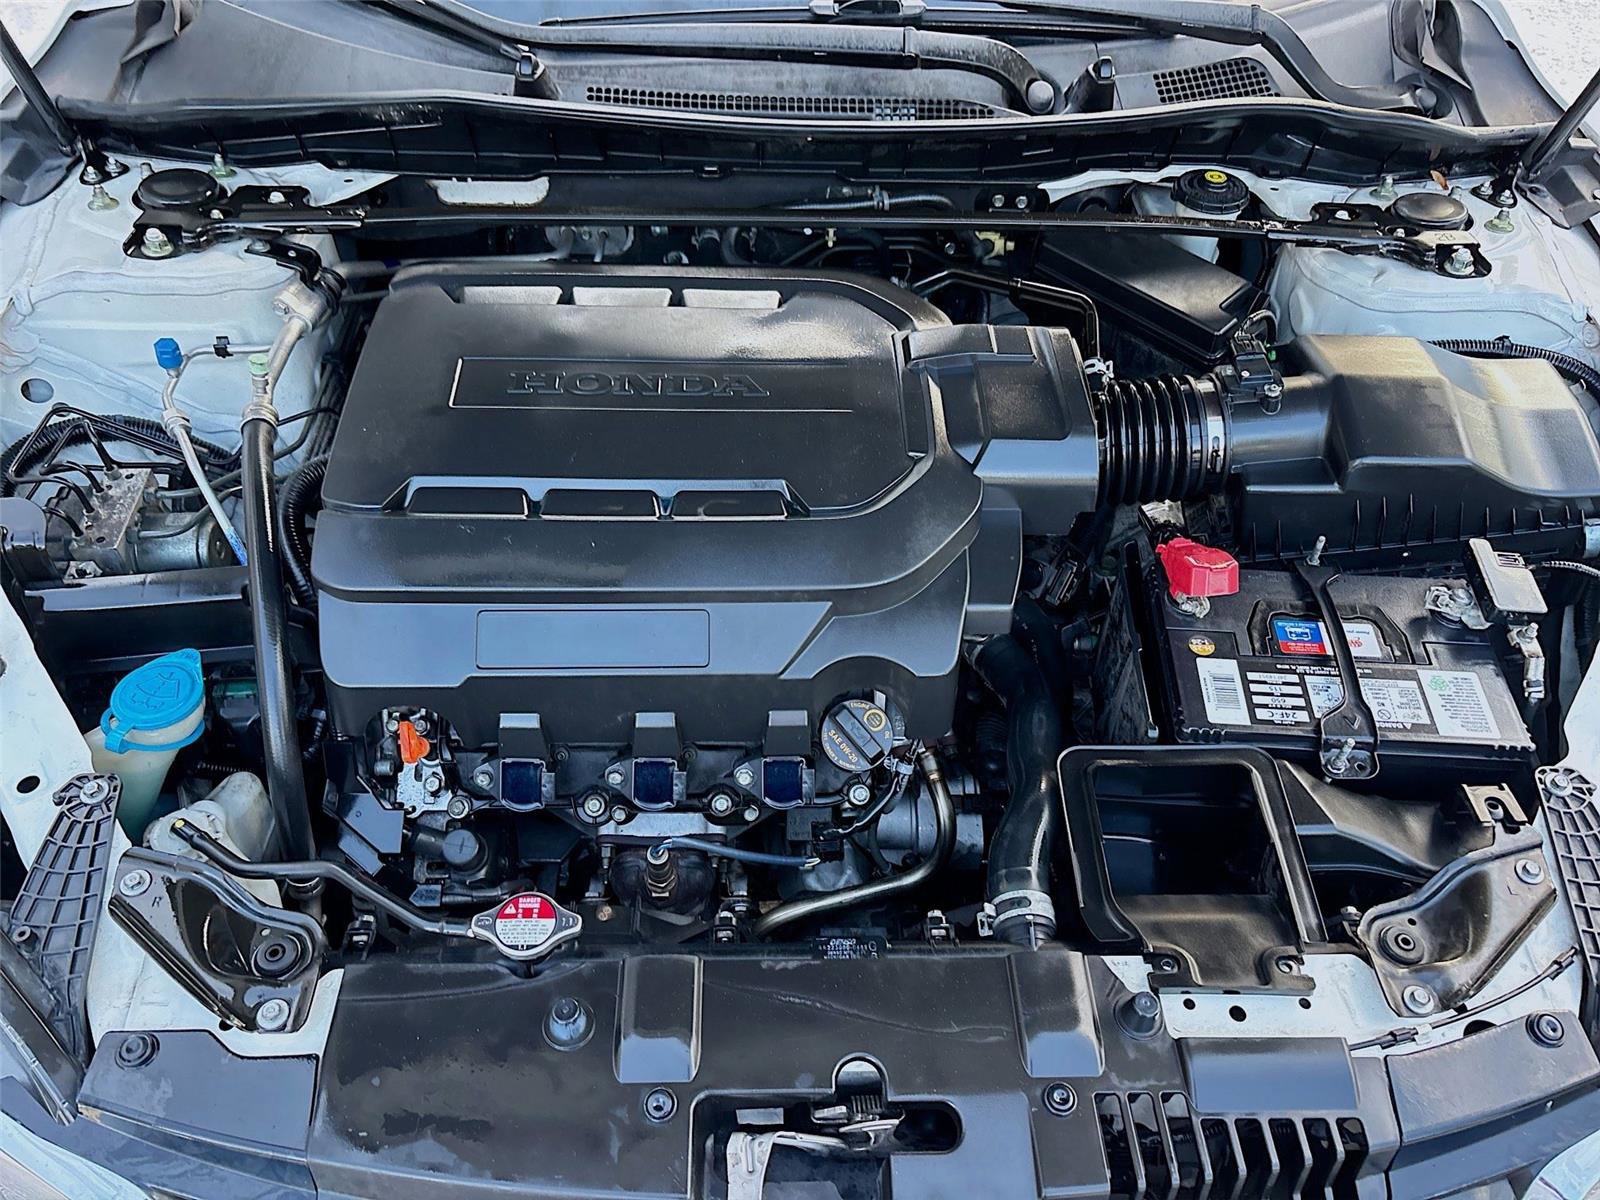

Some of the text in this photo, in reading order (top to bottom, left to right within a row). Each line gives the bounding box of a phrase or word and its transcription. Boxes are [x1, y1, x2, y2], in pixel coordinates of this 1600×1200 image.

[507, 371, 769, 396] HONDA
[1267, 711, 1297, 719] 24F-C
[828, 730, 858, 763] SAE 0W-20
[152, 896, 162, 907] R
